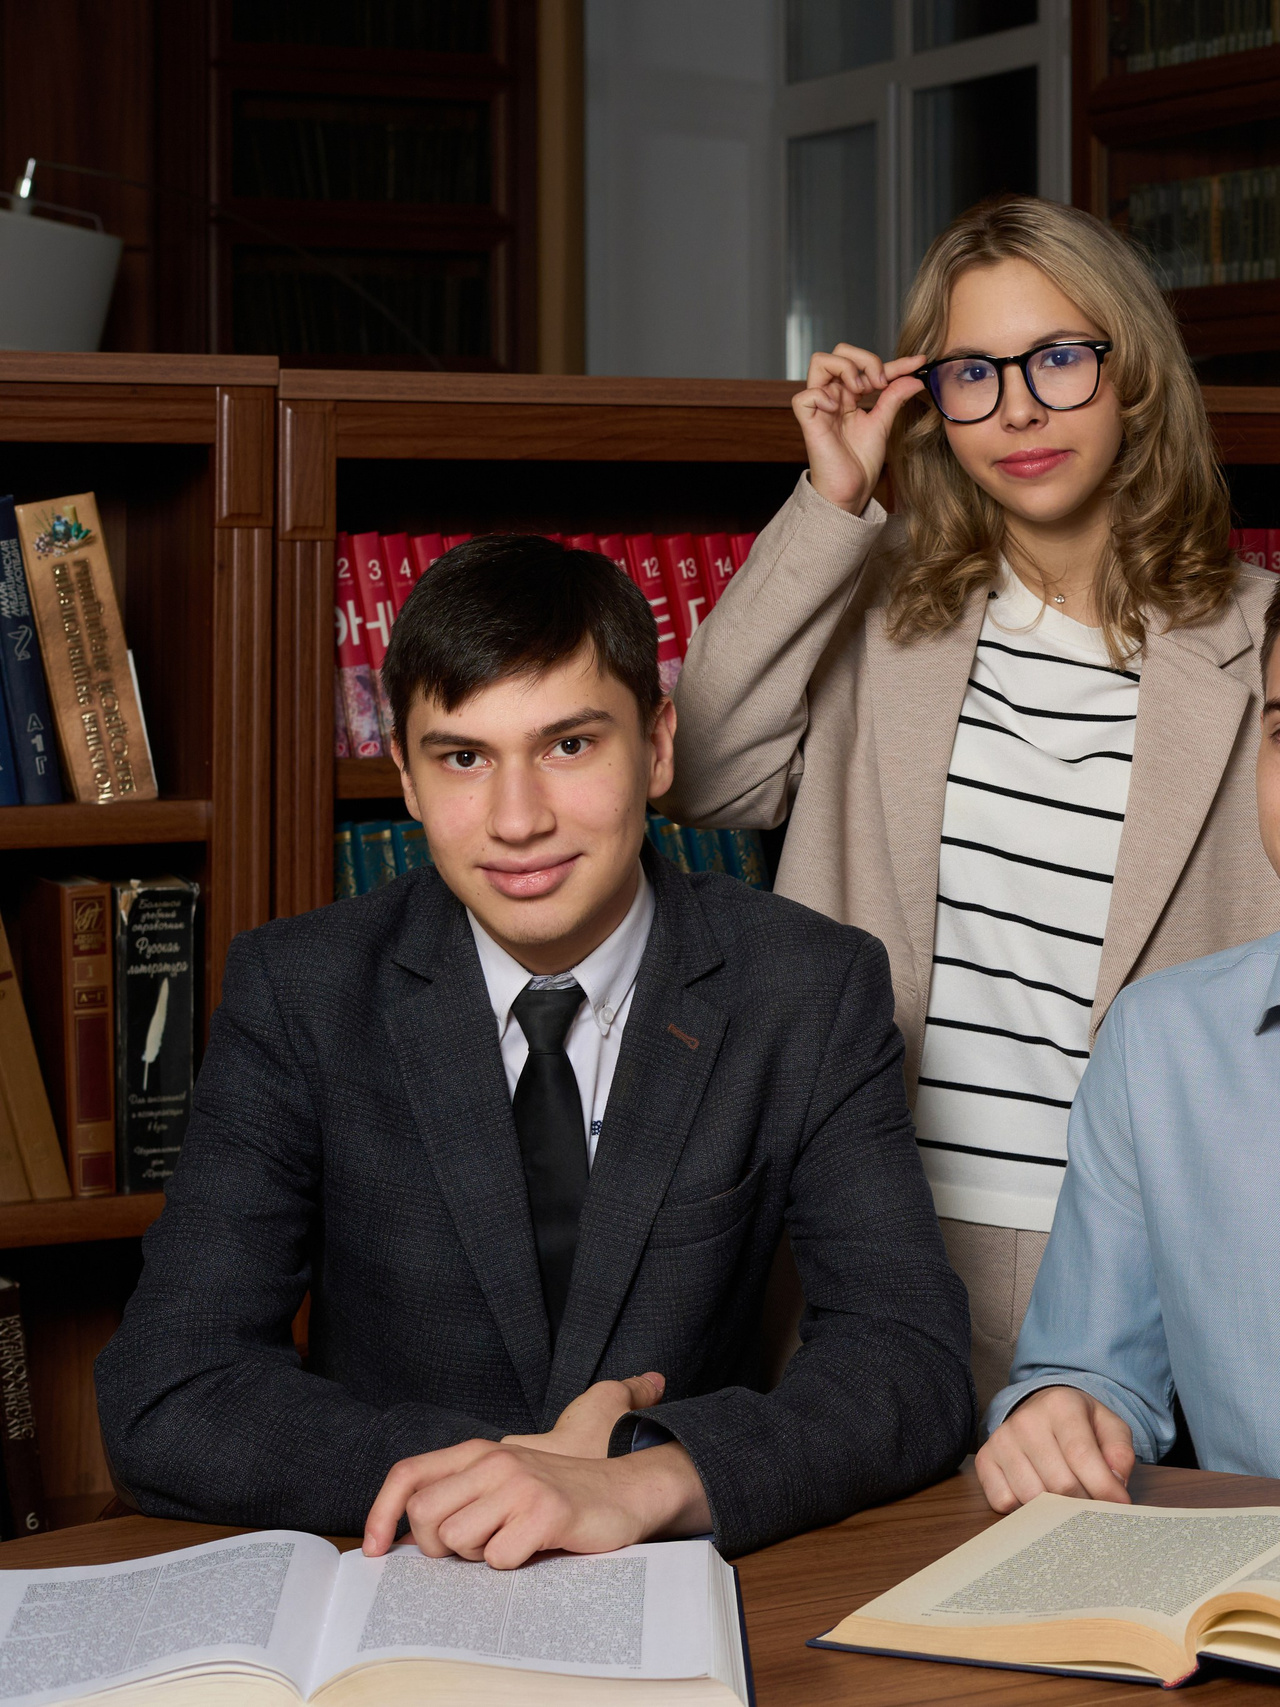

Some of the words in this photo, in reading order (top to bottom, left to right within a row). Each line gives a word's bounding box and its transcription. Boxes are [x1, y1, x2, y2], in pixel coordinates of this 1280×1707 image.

[9, 538, 30, 617] ЭНЦИКЛОПЕДИЯ
[337, 557, 351, 579] 2
[368, 559, 382, 580] 3
[400, 557, 412, 578] 4
[641, 556, 661, 579] 12
[677, 557, 698, 579] 13
[714, 556, 734, 578] 14
[27, 712, 44, 733] А
[31, 734, 44, 752] 1
[8, 1314, 35, 1440] ЭНЦИКЛОПЕДИЯ
[26, 1512, 39, 1530] 6
